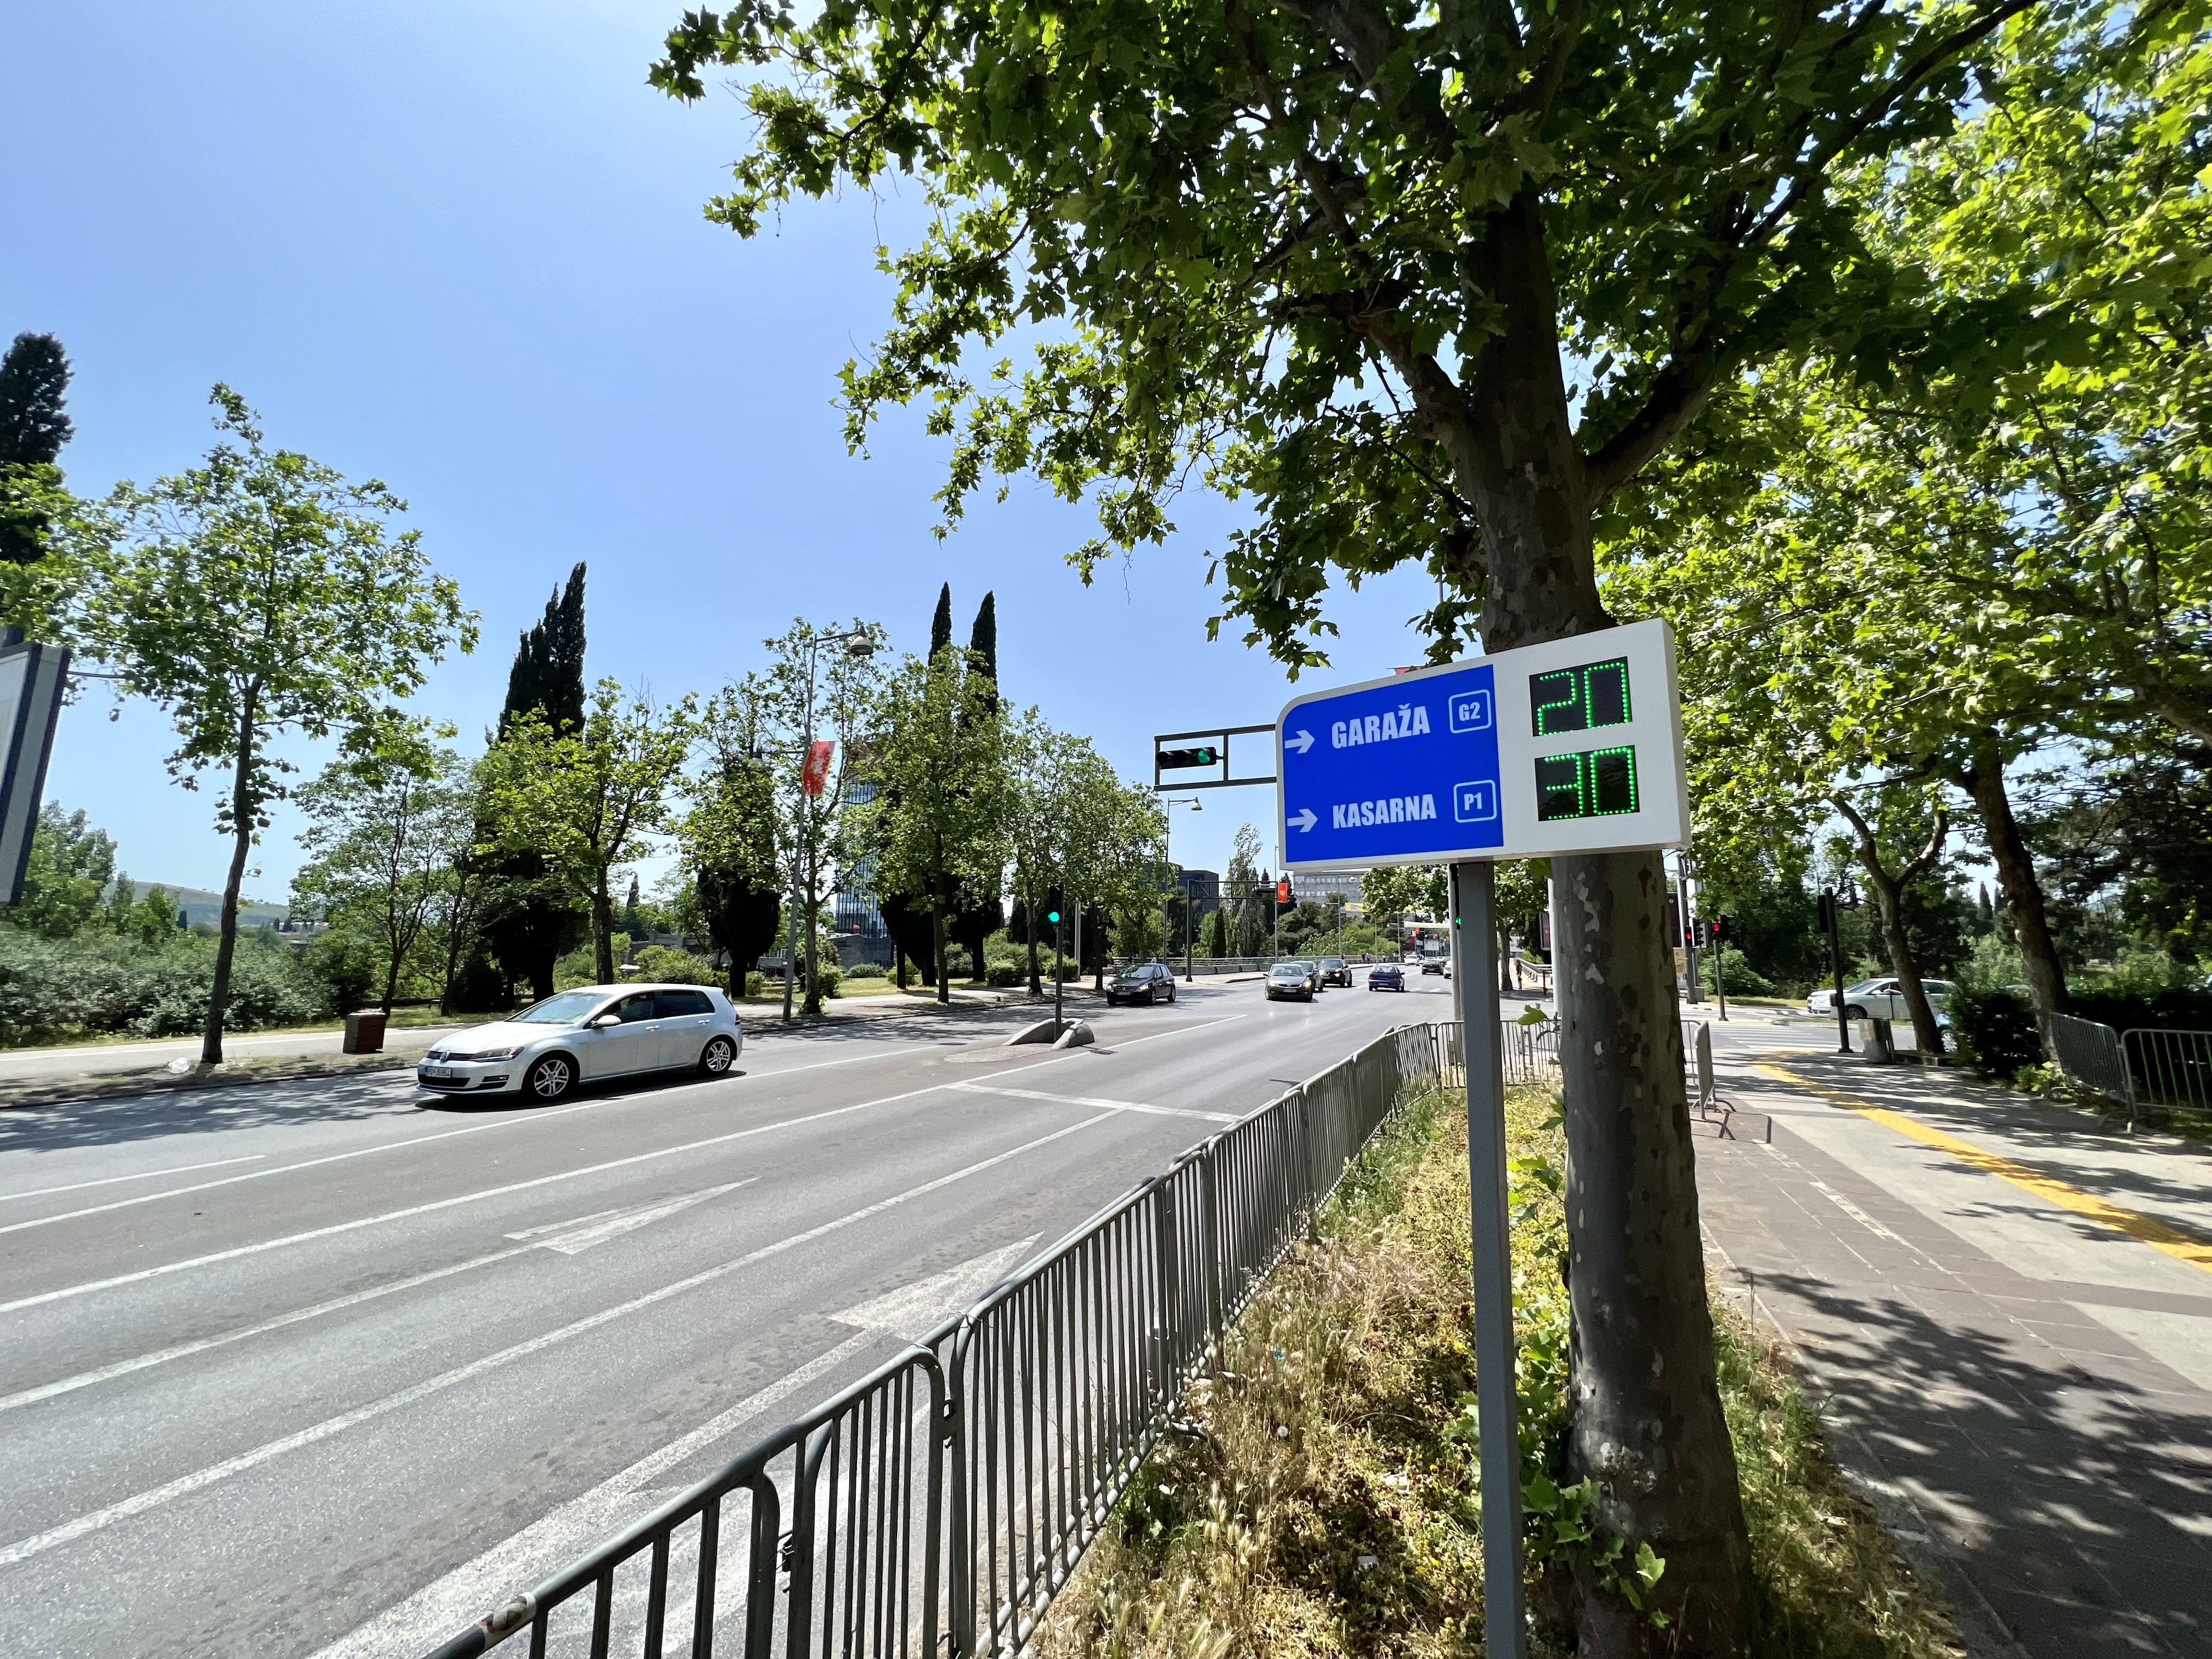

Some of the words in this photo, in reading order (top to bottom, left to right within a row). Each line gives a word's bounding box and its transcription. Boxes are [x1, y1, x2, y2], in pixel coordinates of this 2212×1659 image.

[1331, 703, 1430, 749] GARAŽA
[1458, 702, 1481, 721] G2
[1537, 662, 1630, 737] 20
[1332, 794, 1437, 829] KASARNA
[1464, 792, 1482, 811] P1
[1544, 746, 1636, 820] 30
